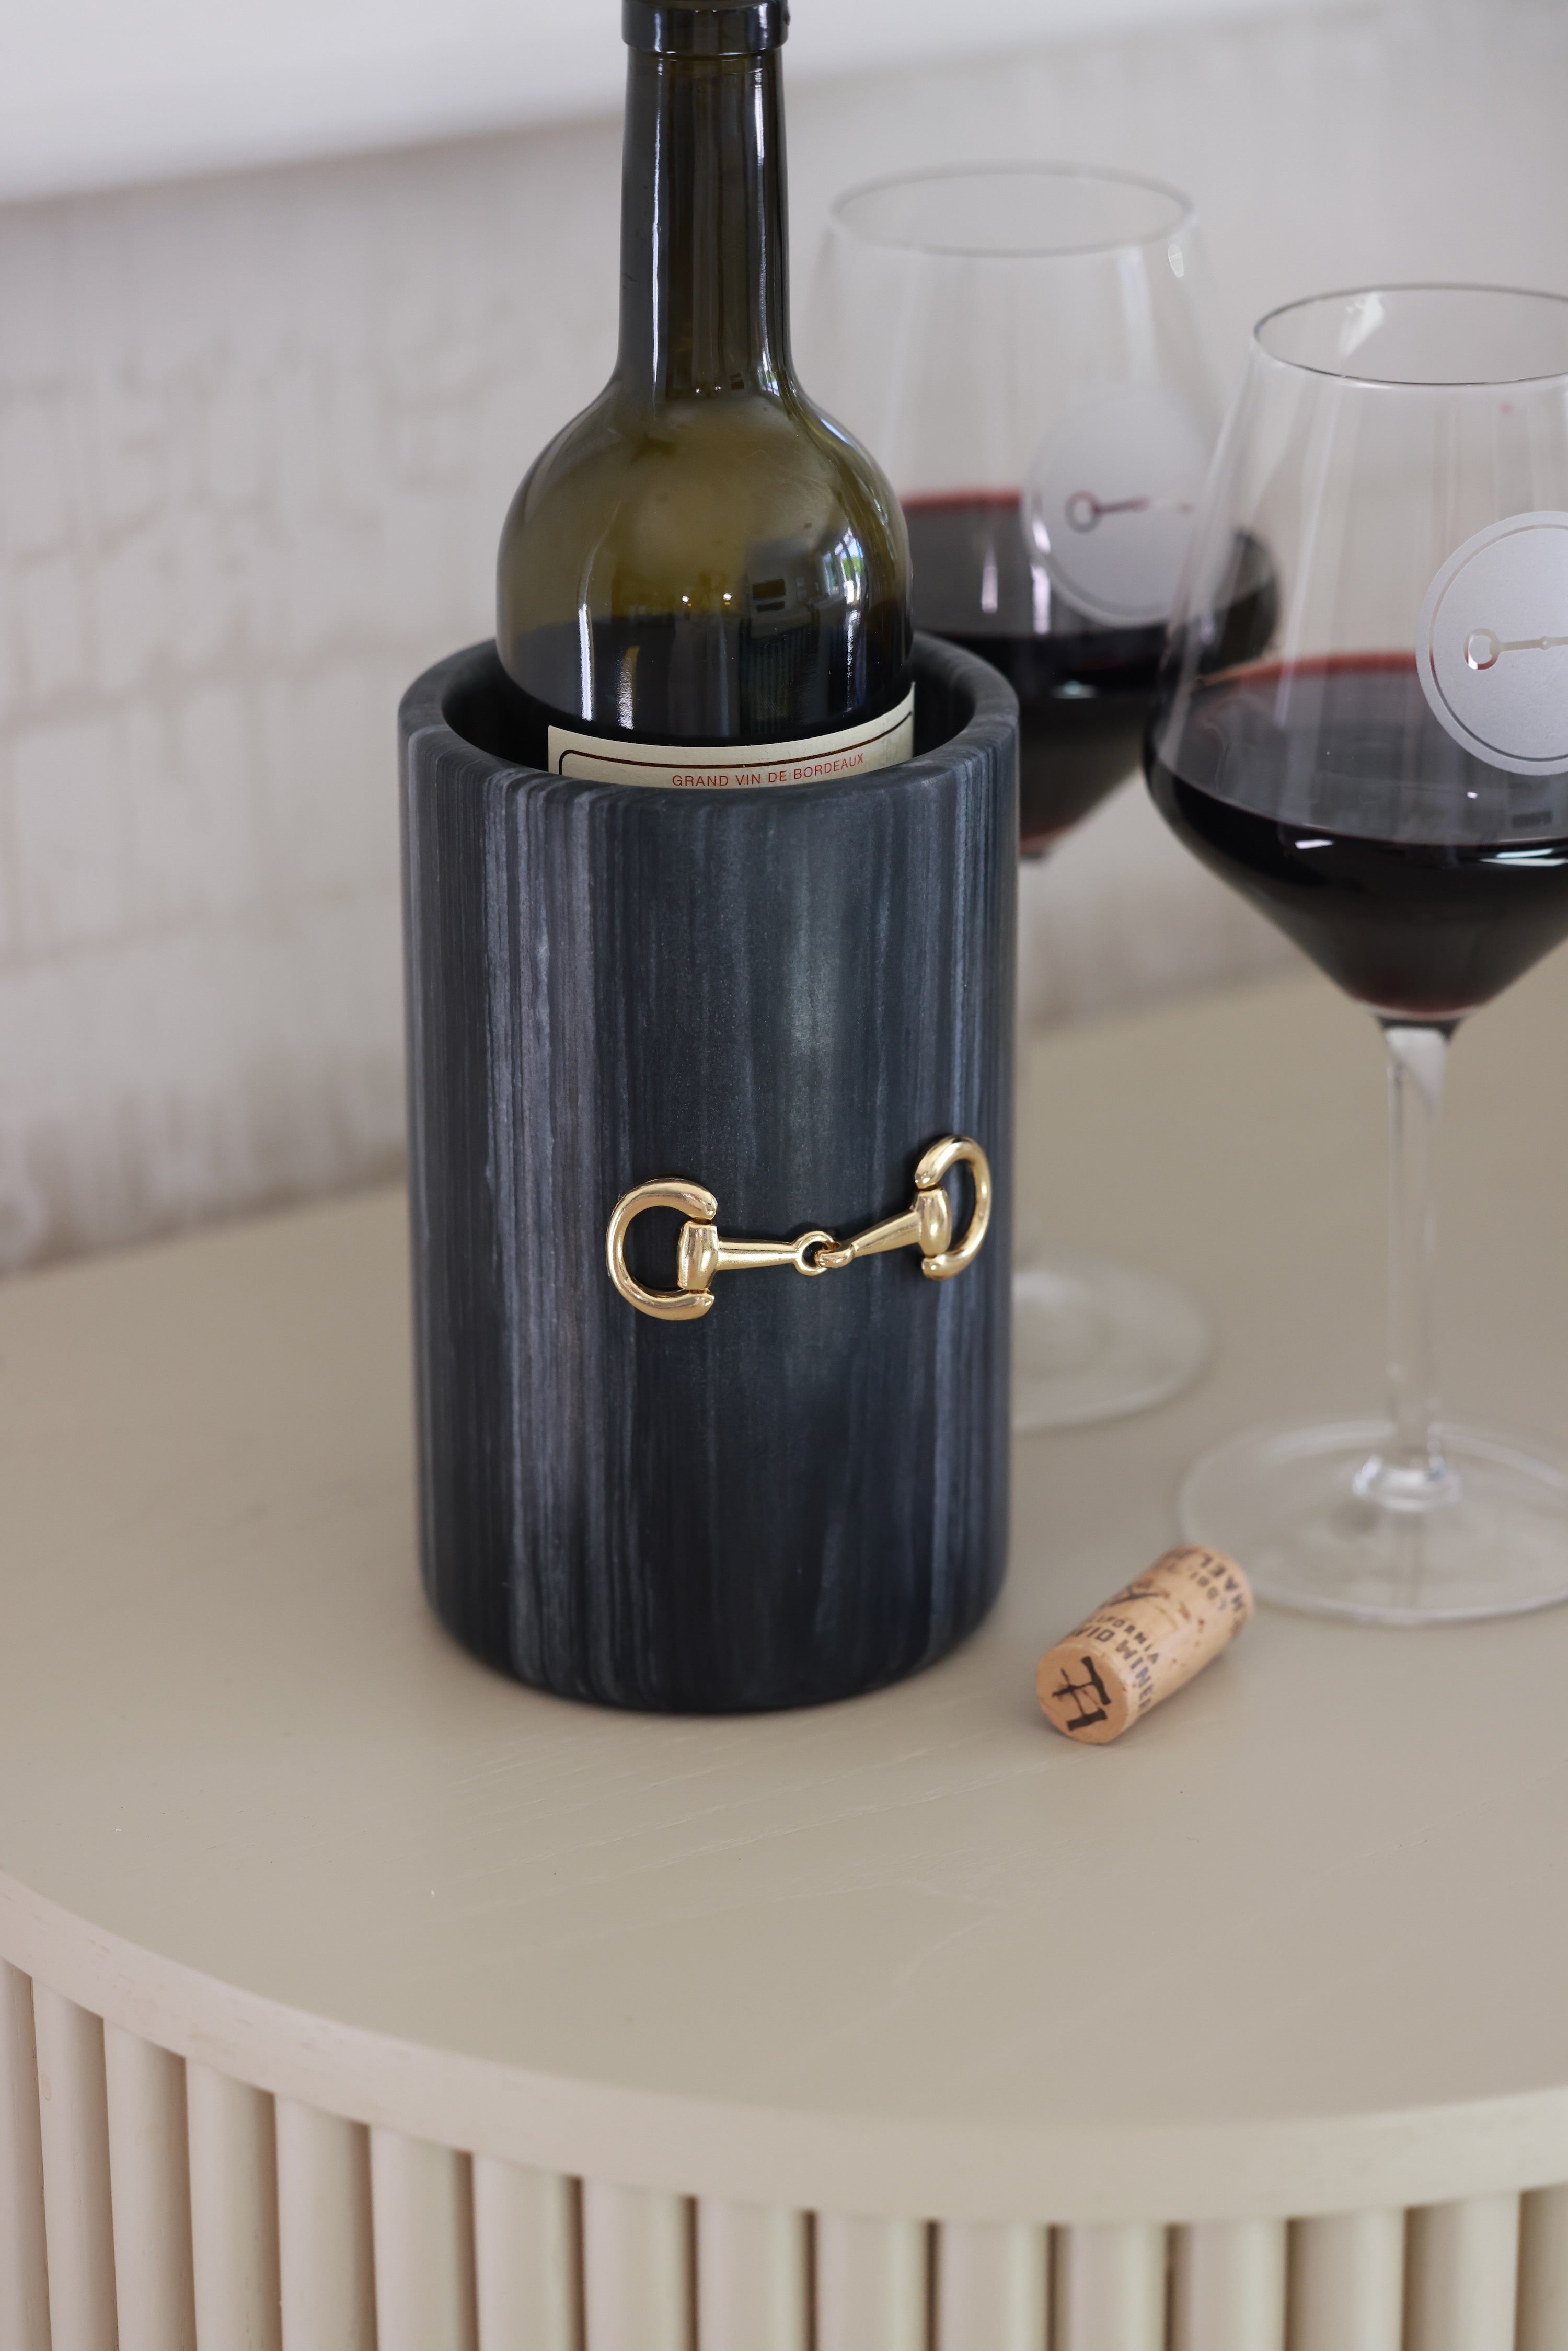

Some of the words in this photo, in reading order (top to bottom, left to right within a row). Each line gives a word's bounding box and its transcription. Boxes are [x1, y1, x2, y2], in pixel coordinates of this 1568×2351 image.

[672, 774, 729, 787] GRAND
[735, 773, 761, 785] VIN
[768, 770, 787, 783] DE
[793, 752, 864, 780] BORDEAUX
